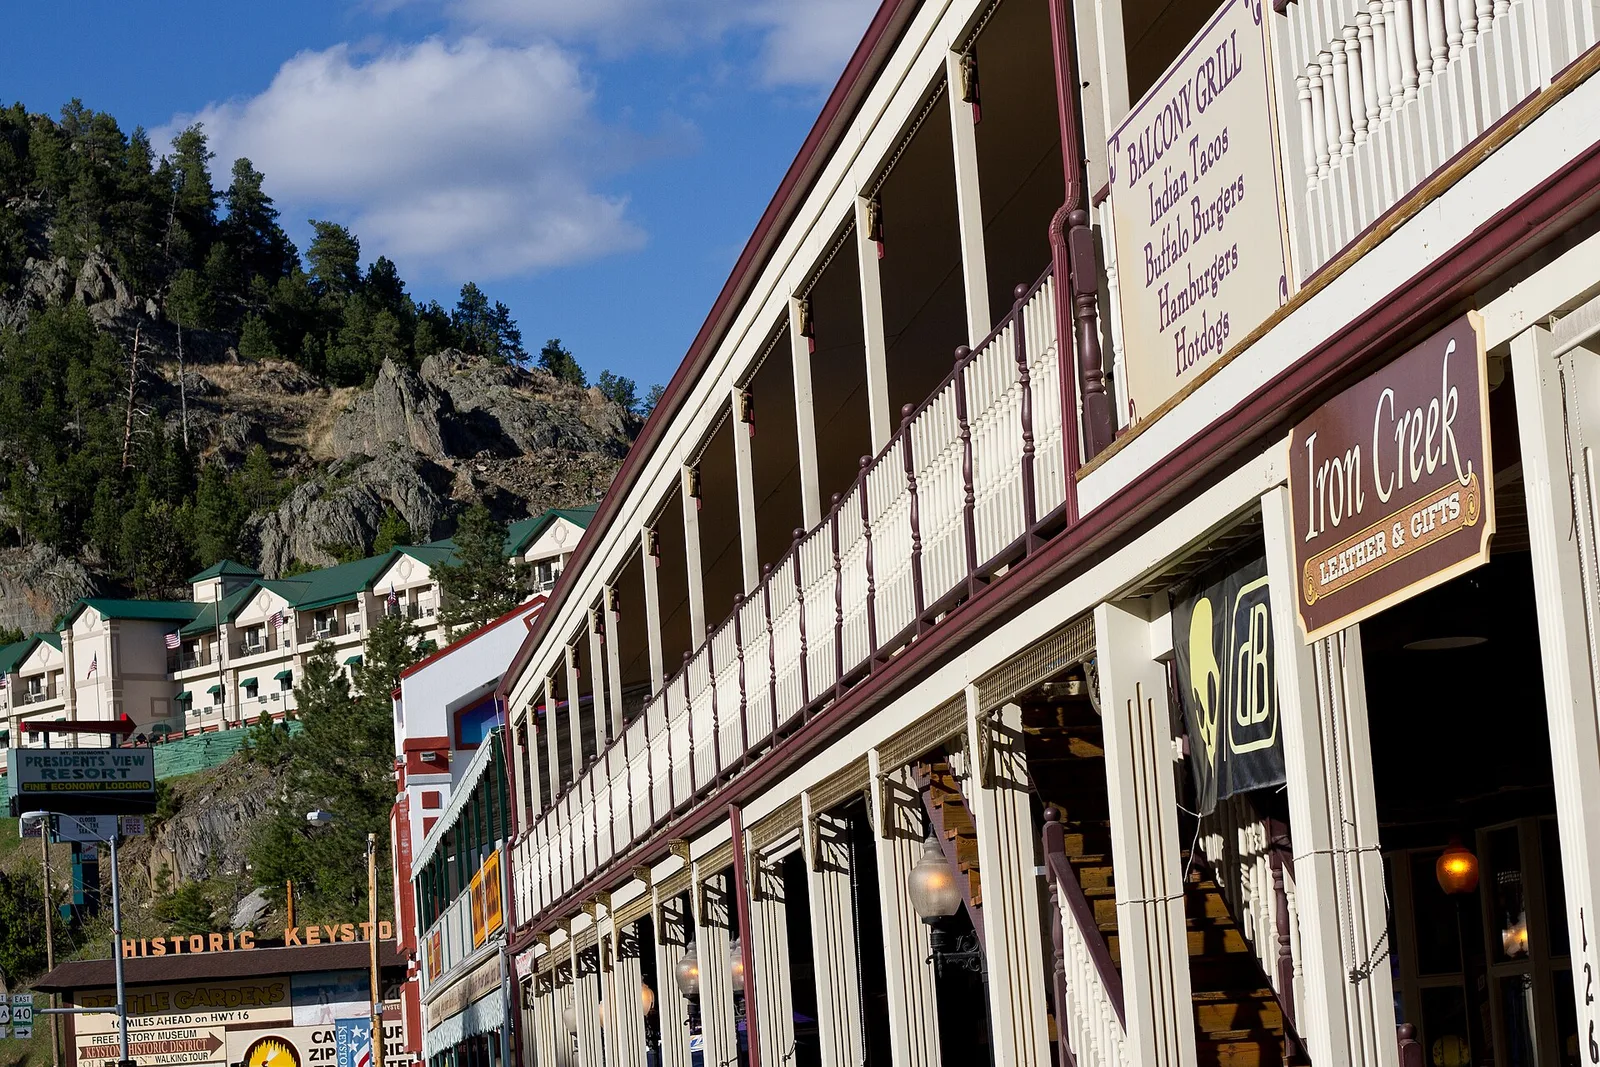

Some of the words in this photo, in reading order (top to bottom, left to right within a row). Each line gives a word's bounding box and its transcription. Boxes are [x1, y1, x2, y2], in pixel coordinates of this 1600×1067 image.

[1126, 78, 1194, 189] BALCONY
[1194, 28, 1242, 115] GRILL
[1148, 165, 1189, 228] Indian
[1188, 125, 1230, 187] Tacos
[1144, 214, 1190, 289] Buffalo
[1191, 173, 1245, 246] Burgers
[1157, 242, 1239, 334] Hamburgers
[1174, 310, 1230, 378] Hotdogs
[1304, 431, 1365, 544] Iron
[1372, 338, 1474, 504] Creek
[1319, 530, 1387, 586] LEATHER
[1390, 526, 1406, 549] &
[1410, 490, 1462, 540] GIFTS
[25, 756, 105, 768] PRESIDENTS
[112, 755, 145, 766] VIEW
[40, 768, 131, 780] RESORT
[24, 782, 48, 791] FINE
[51, 782, 100, 790] ECONOMY
[106, 781, 150, 790] LODGING
[125, 824, 140, 834] FREE
[122, 930, 254, 958] HISTORIC
[284, 920, 392, 947] KEYSTO
[82, 992, 170, 1016] RETILE
[174, 983, 285, 1011] GARDENS
[14, 1008, 30, 1020] 40
[126, 1018, 154, 1028] MILES
[156, 1016, 192, 1026] AHEAD
[195, 1015, 208, 1023] on
[211, 1012, 235, 1022] HWY
[237, 1011, 250, 1020] 16
[86, 1046, 121, 1058] KEYSTON
[128, 1042, 168, 1054] HISTORIC
[170, 1038, 208, 1052] DISTRICT
[92, 1034, 114, 1044] FREE
[116, 1032, 156, 1044] HSTORY
[158, 1029, 197, 1040] MUSEUM
[311, 1030, 336, 1044] CA
[338, 1026, 348, 1067] KEYSTO
[155, 1054, 188, 1064] WALKING
[190, 1052, 209, 1061] TOUR
